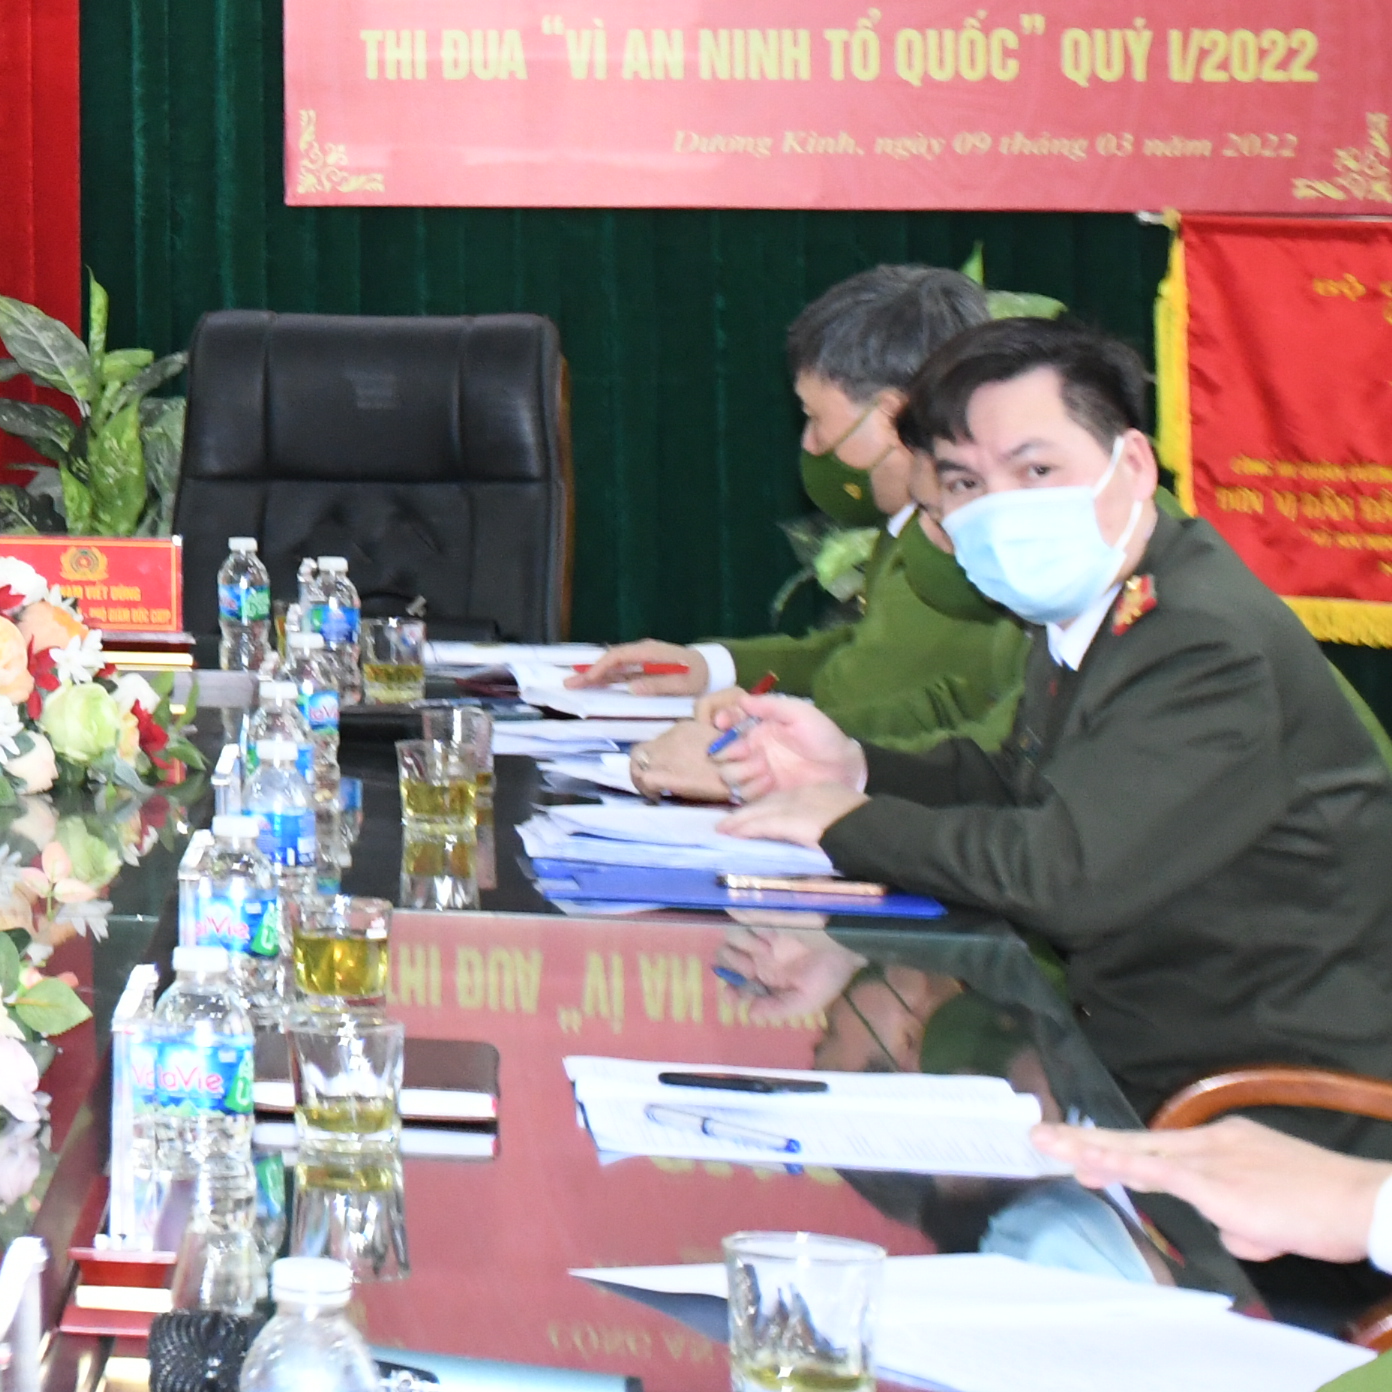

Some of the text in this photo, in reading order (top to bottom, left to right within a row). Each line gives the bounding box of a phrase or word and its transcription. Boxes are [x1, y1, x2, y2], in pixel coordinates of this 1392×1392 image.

[359, 28, 430, 81] THI
[439, 28, 529, 82] ĐUA
[621, 27, 686, 81] AN
[697, 27, 813, 81] NINH
[823, 6, 883, 83] TỔ
[1167, 27, 1320, 83] I/2022
[1222, 132, 1298, 157] 2022
